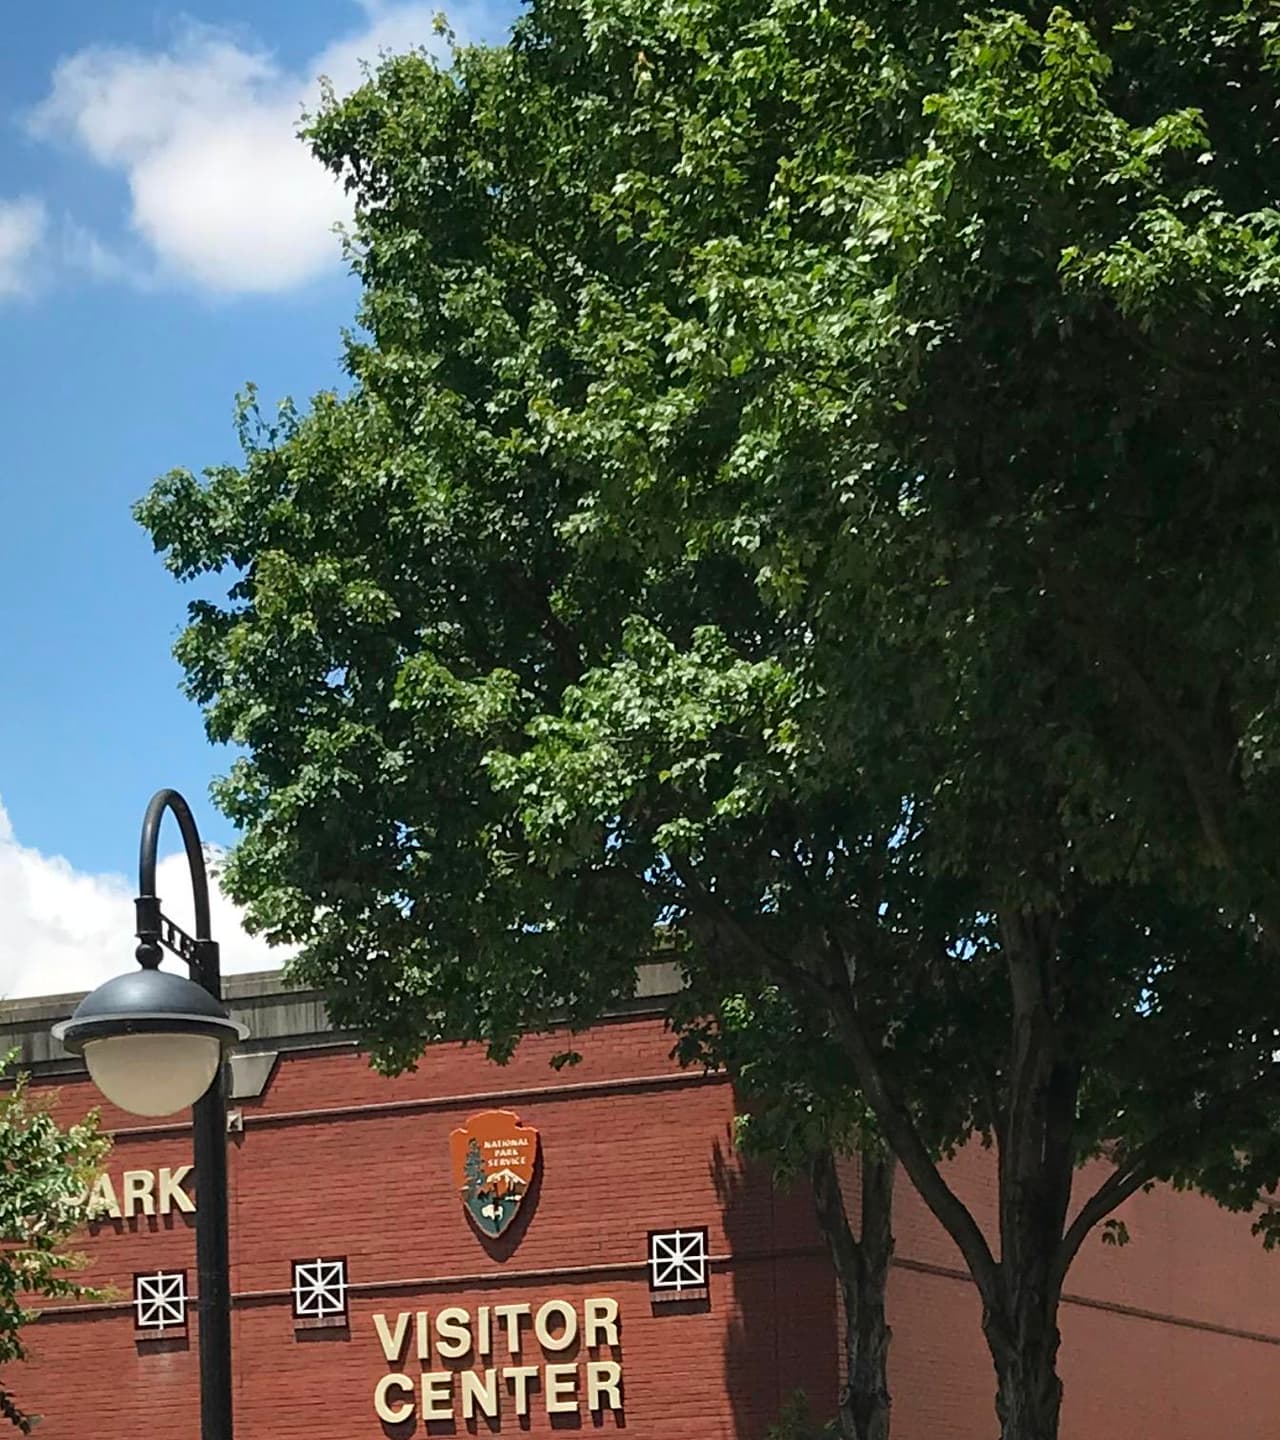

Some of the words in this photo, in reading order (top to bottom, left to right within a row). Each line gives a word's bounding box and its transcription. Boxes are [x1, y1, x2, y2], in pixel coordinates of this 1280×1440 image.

[483, 1138, 529, 1149] NATIONAL
[494, 1149, 519, 1158] PARK
[487, 1156, 527, 1168] SERVICE
[372, 1297, 619, 1361] VISITOR
[374, 1360, 622, 1424] CENTER
